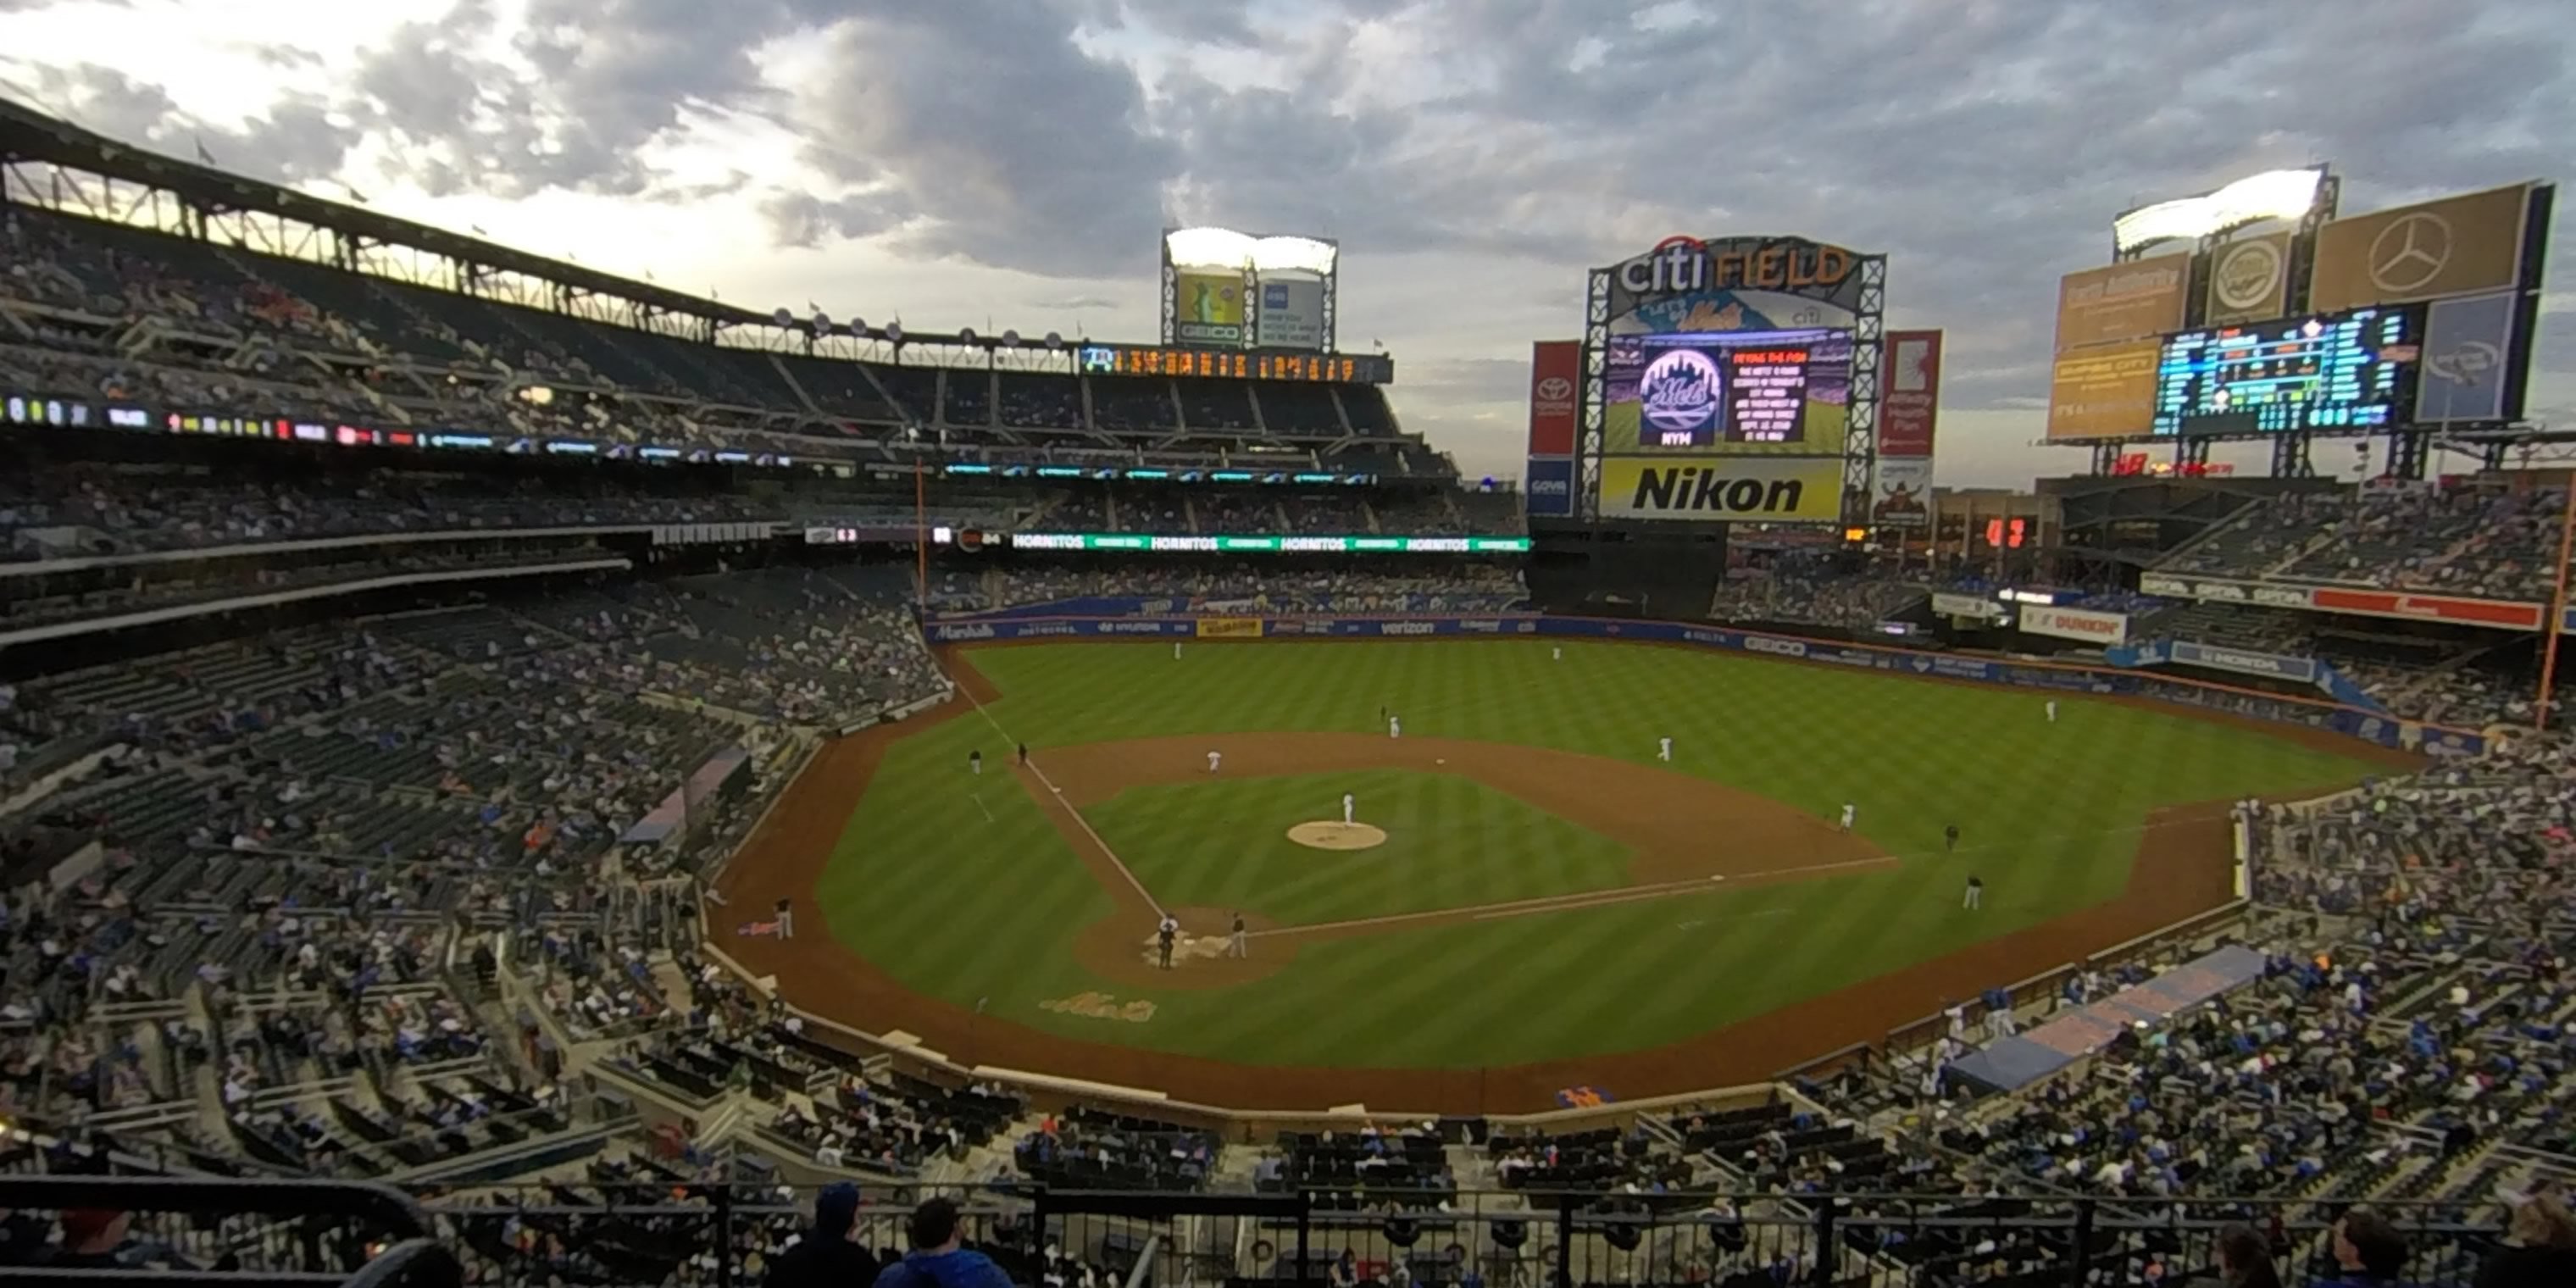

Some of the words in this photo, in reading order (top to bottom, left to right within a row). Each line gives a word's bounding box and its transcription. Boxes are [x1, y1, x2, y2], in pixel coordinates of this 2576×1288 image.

[1717, 248, 1851, 286] FIELD
[1661, 432, 1691, 446] NYM
[1632, 467, 1803, 513] Nikon
[1013, 535, 1085, 548] HORNITOS
[1151, 536, 1219, 550] HORNITOS
[1280, 537, 1346, 551] HORNITOS
[1381, 620, 1434, 634] verizon
